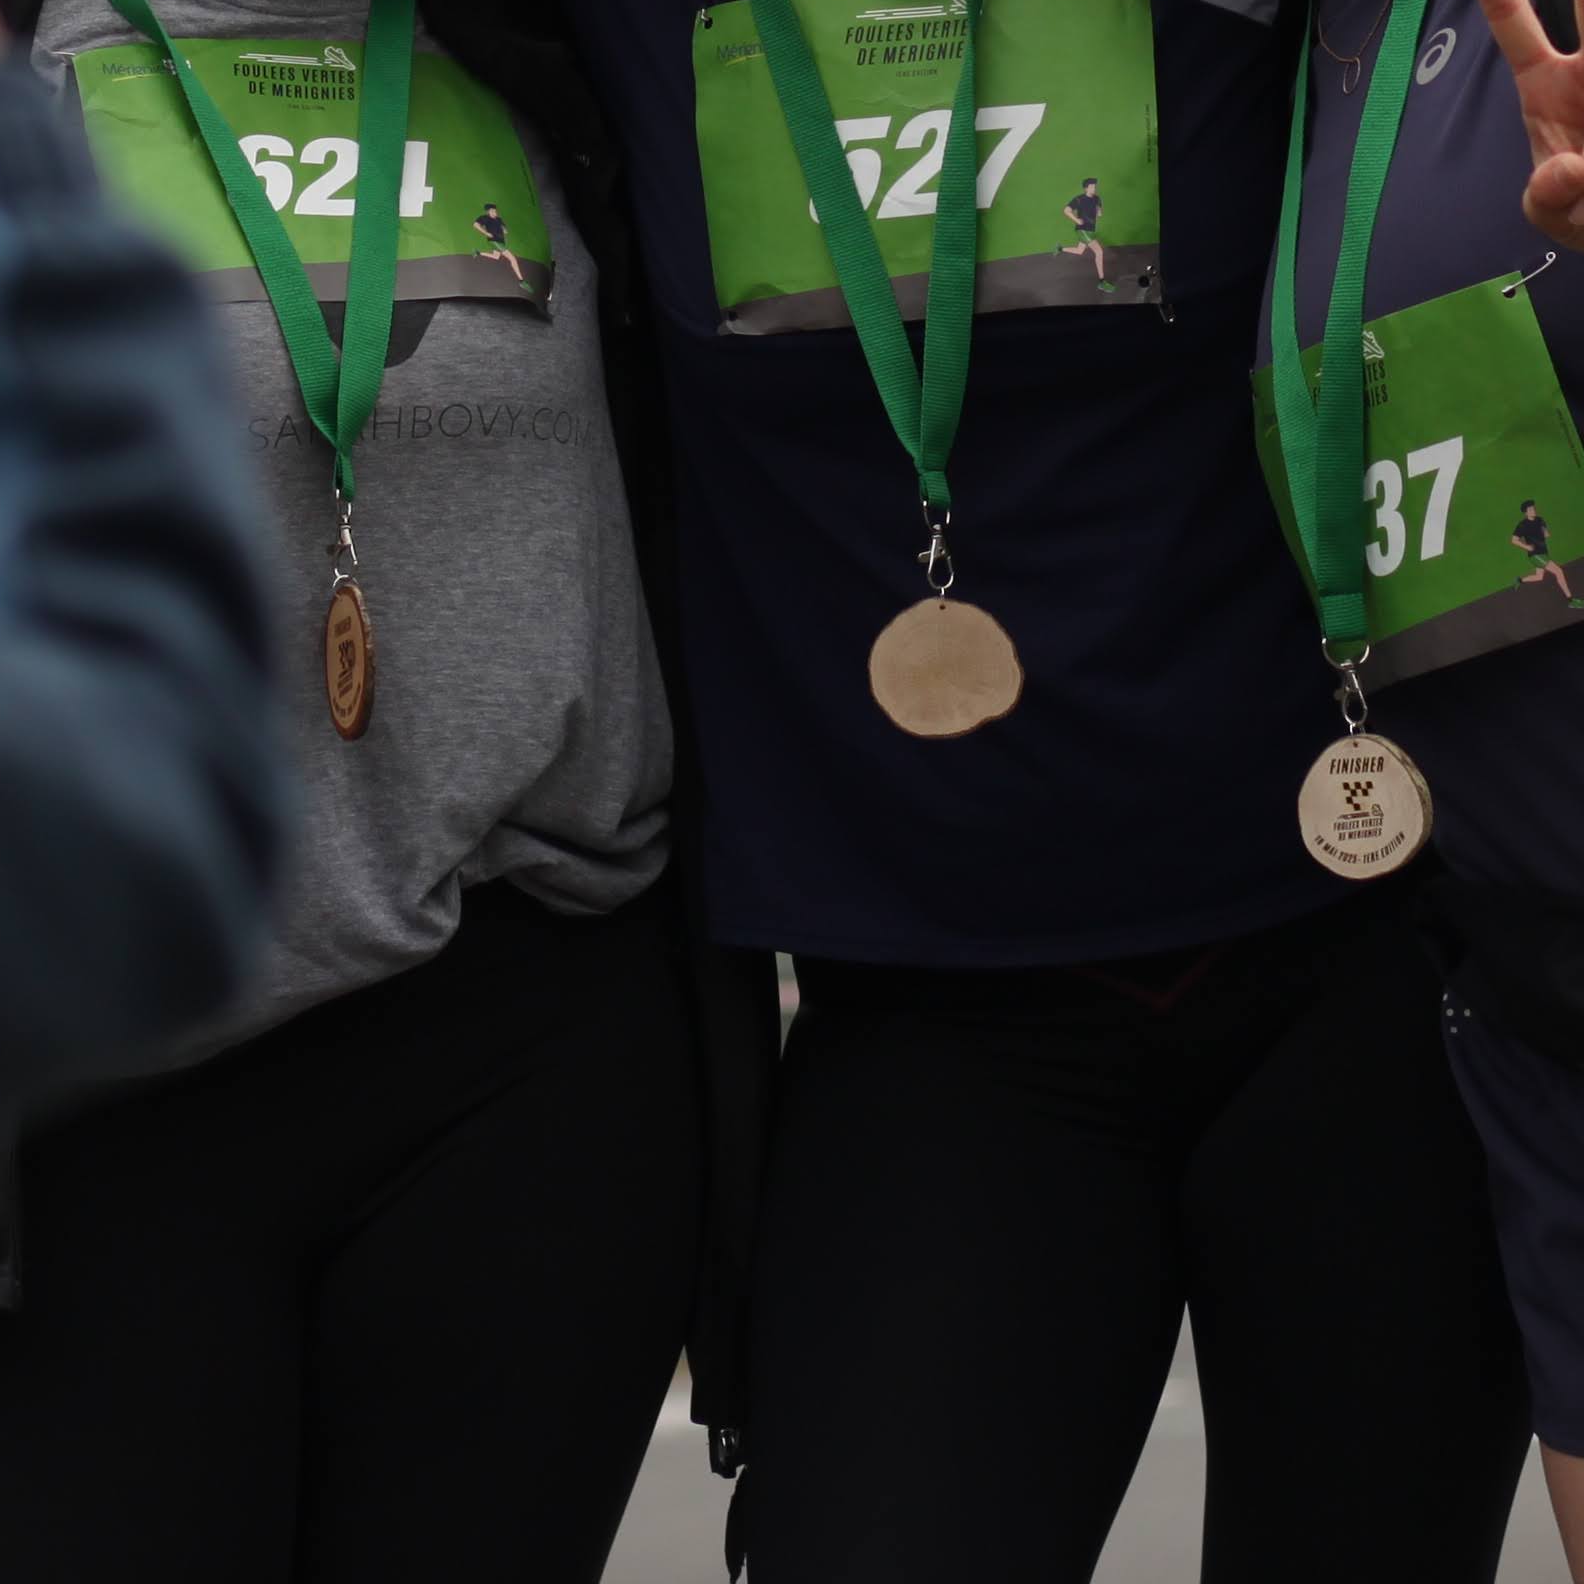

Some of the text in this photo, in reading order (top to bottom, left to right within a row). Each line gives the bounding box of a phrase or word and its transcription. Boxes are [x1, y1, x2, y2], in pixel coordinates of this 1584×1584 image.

[845, 18, 969, 45] FOULEES VERTE
[856, 41, 966, 66] DE MERIGNIE
[233, 63, 356, 85] FOULEES VERTES
[248, 80, 356, 101] DE MERIGNIES
[238, 133, 434, 218] 624
[809, 102, 1047, 224] 527
[247, 403, 592, 453] SAHBOVY.COM
[1363, 436, 1464, 578] 37
[1329, 756, 1385, 775] FINISHER
